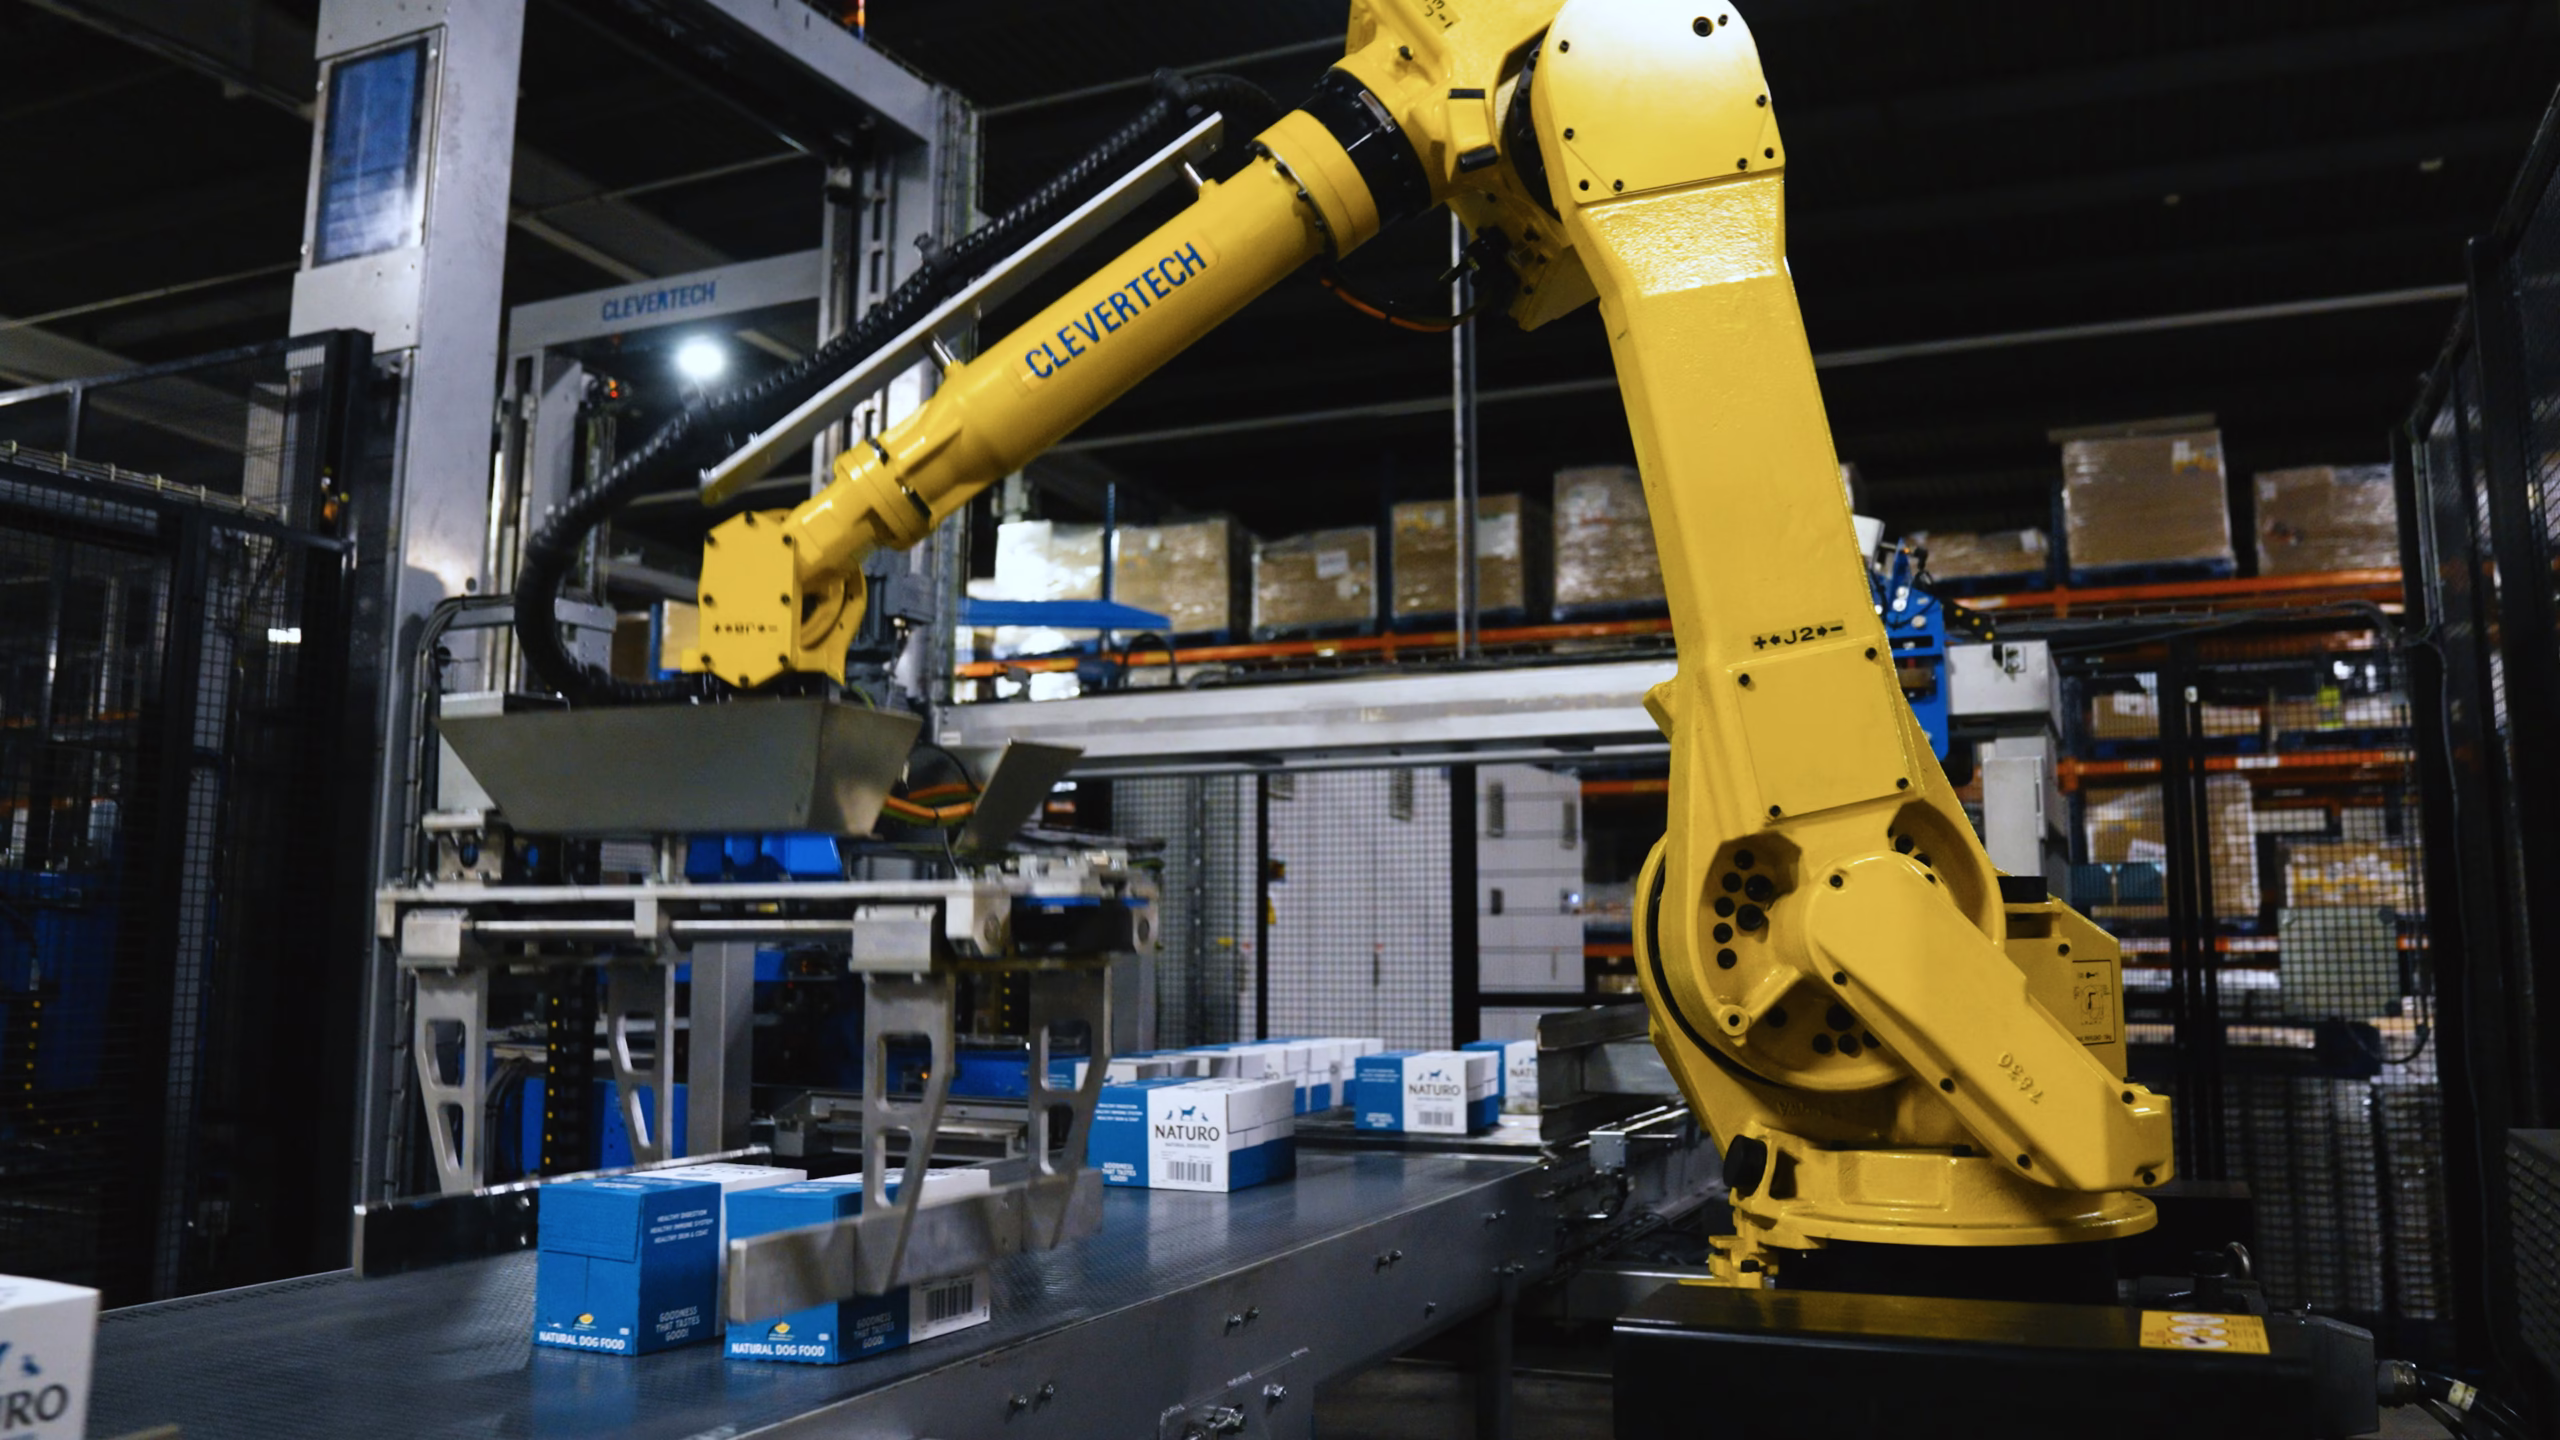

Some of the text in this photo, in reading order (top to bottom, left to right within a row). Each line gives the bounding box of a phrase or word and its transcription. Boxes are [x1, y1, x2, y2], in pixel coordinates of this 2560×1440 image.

[602, 281, 717, 322] CLEVERTECH
[1025, 241, 1207, 379] CLEVERTECH
[1408, 1083, 1461, 1097] NATURO
[1154, 1124, 1220, 1142] NATURO
[659, 1305, 698, 1322] GOODNESS
[656, 1315, 701, 1333] THAT TASTES
[539, 1331, 626, 1350] NATURAL DOG FOOD
[665, 1328, 690, 1342] GOOD!
[731, 1343, 825, 1357] NATURAL DOG FOOD
[0, 1383, 69, 1430] RO
